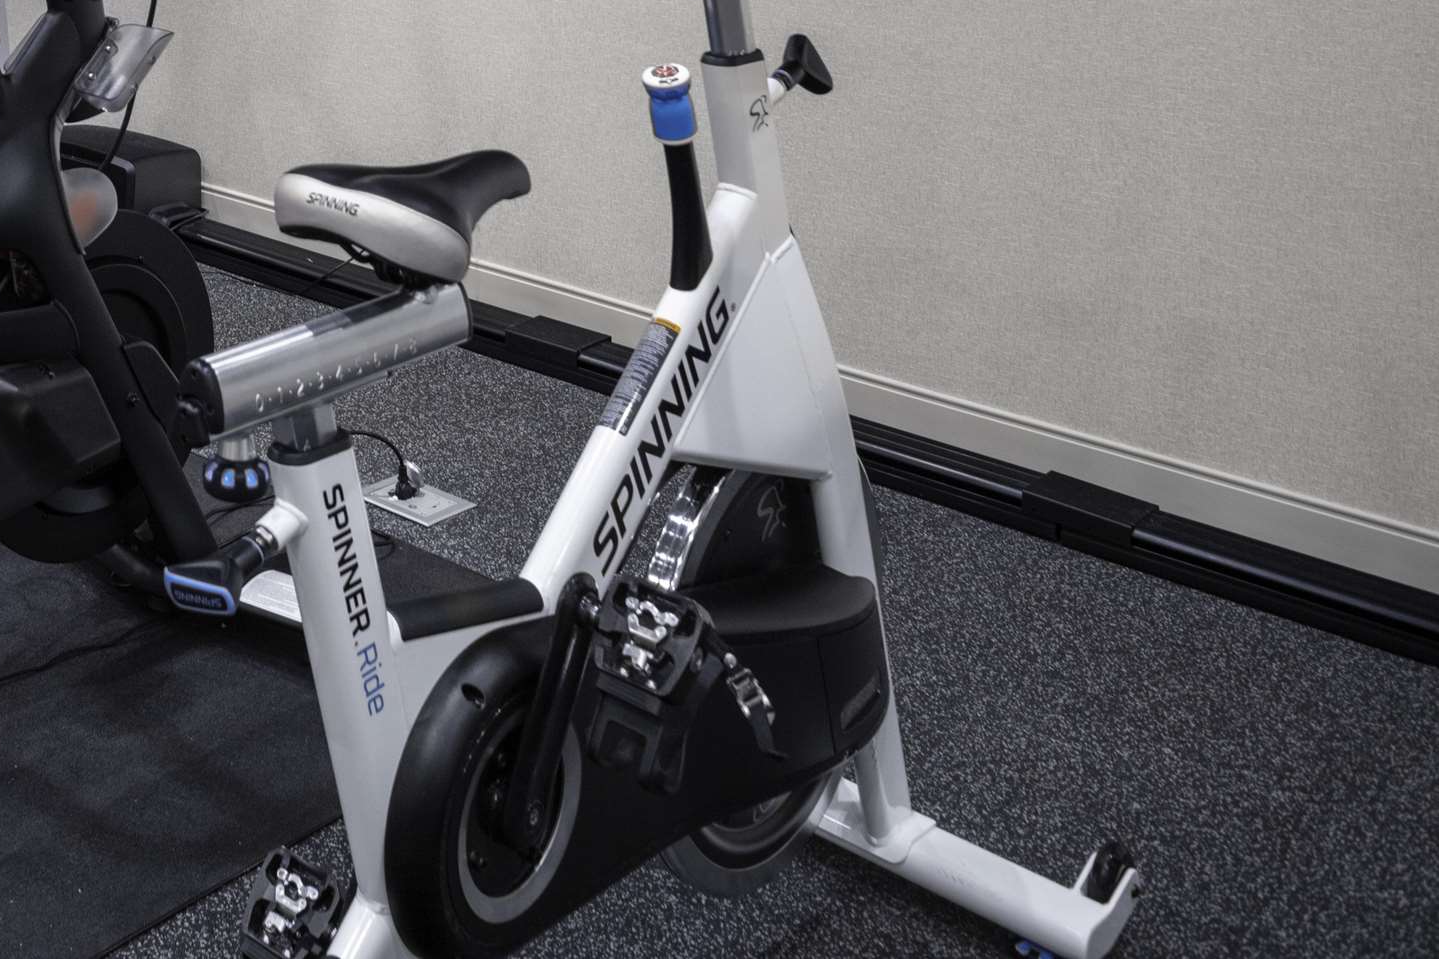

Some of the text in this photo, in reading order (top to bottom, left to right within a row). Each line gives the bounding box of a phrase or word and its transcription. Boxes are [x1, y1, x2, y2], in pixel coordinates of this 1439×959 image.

[593, 286, 729, 577] SPINNING
[323, 483, 385, 717] SPINNER Ride
